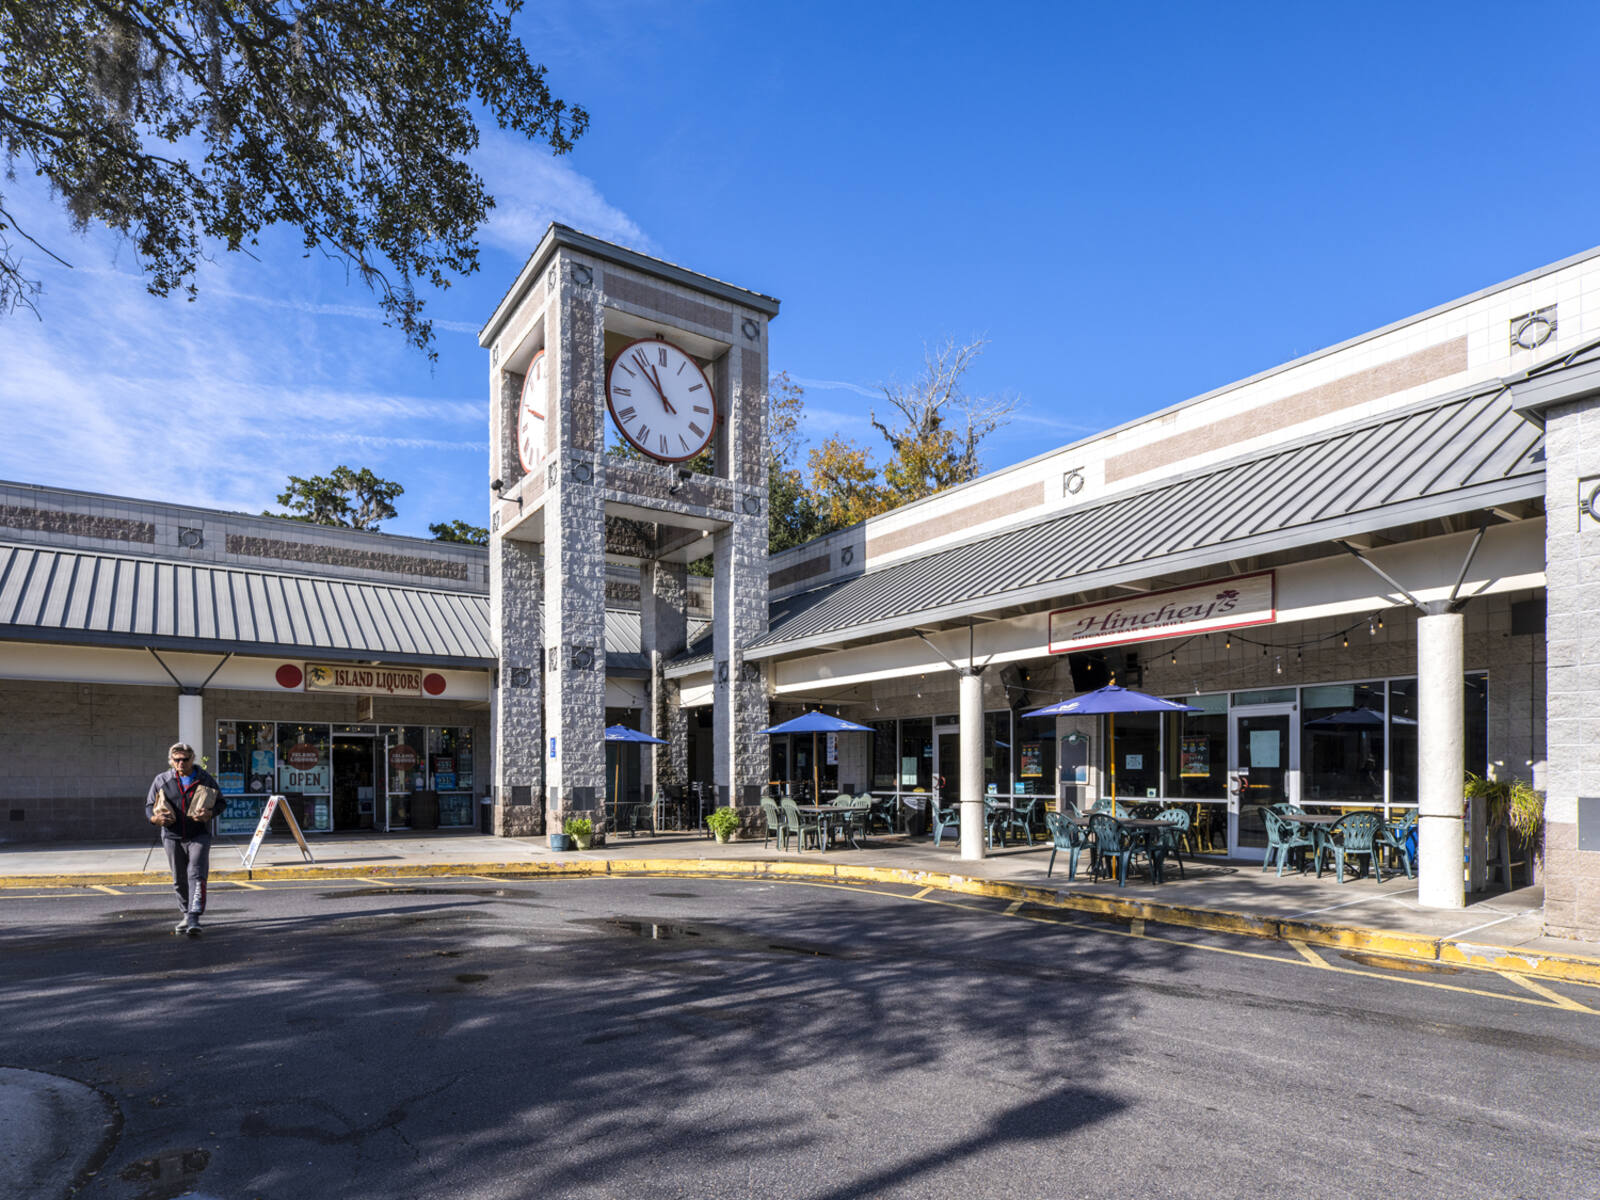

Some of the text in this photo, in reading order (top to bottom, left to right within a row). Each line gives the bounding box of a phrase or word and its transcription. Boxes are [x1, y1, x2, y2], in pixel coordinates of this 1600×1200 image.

[1073, 599, 1239, 637] Hinchey's
[335, 669, 420, 693] ISLAND LIQUORS
[289, 772, 321, 786] OPEN
[226, 798, 254, 810] Play
[222, 808, 257, 818] Here
